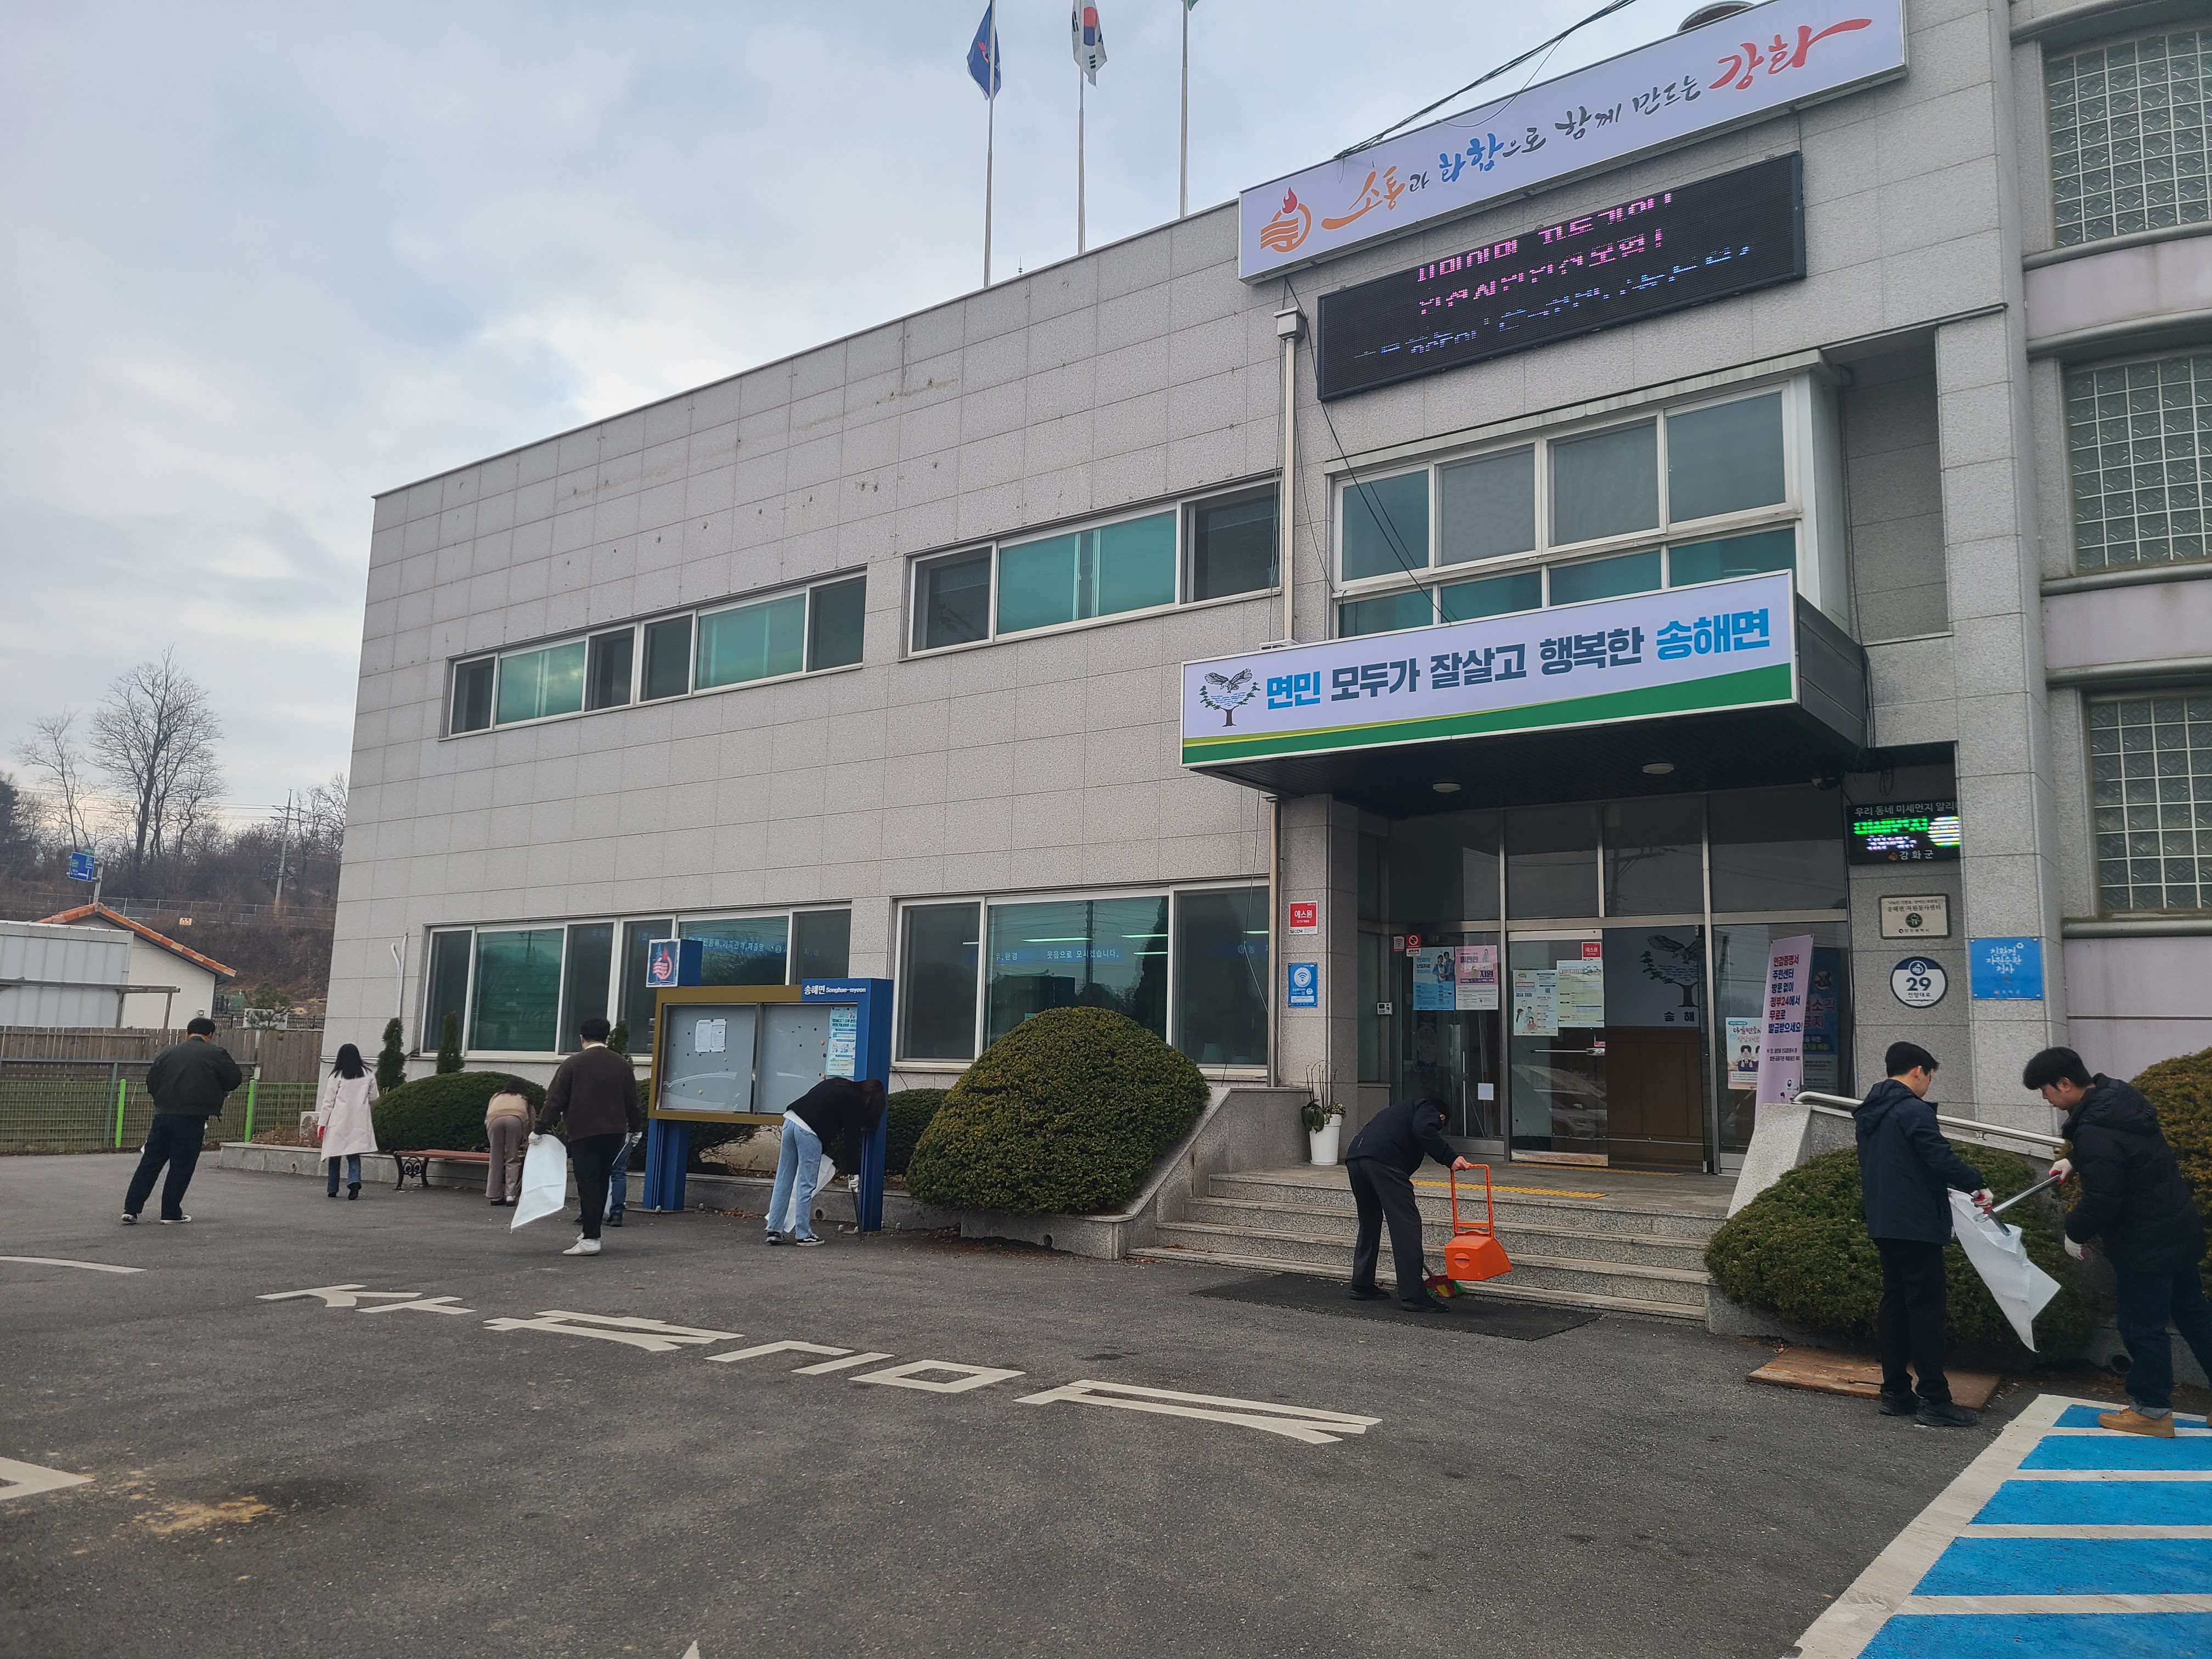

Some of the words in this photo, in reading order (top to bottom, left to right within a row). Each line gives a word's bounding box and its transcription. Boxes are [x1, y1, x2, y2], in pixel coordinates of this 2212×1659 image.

[1321, 165, 1430, 230] 소통과
[1439, 127, 1546, 184] 화합으로
[1555, 103, 1622, 140] 함께
[1632, 75, 1702, 115] 만드는
[1708, 18, 1872, 91] 강화
[1266, 669, 1321, 710] 면민
[1330, 659, 1420, 702] 모두가
[1430, 644, 1527, 690] 잘살고
[1538, 626, 1645, 676] 행복한
[1656, 607, 1771, 662] 송해면
[1854, 807, 1873, 817] 우리
[1875, 805, 1893, 815] 동네
[1896, 803, 1933, 814] 미세먼지
[1936, 801, 1958, 812] 알리
[1899, 849, 1934, 861] 강화군
[1294, 909, 1312, 918] 에스원
[1046, 950, 1073, 959] 웃음으로
[1076, 949, 1119, 959] 모시겠습니다.
[1774, 954, 1799, 967] 인감증명서
[1772, 968, 1795, 980] 주민센터
[804, 985, 826, 995] 송해면
[1771, 983, 1782, 994] 방문
[1783, 981, 1794, 993] 없이
[1906, 977, 1932, 991] 29
[1770, 995, 1801, 1008] 정부24에서
[1769, 1009, 1786, 1020] 무료로
[1768, 1022, 1803, 1034] 발급받으세요!
[256, 1284, 1383, 1444] 주차금지
